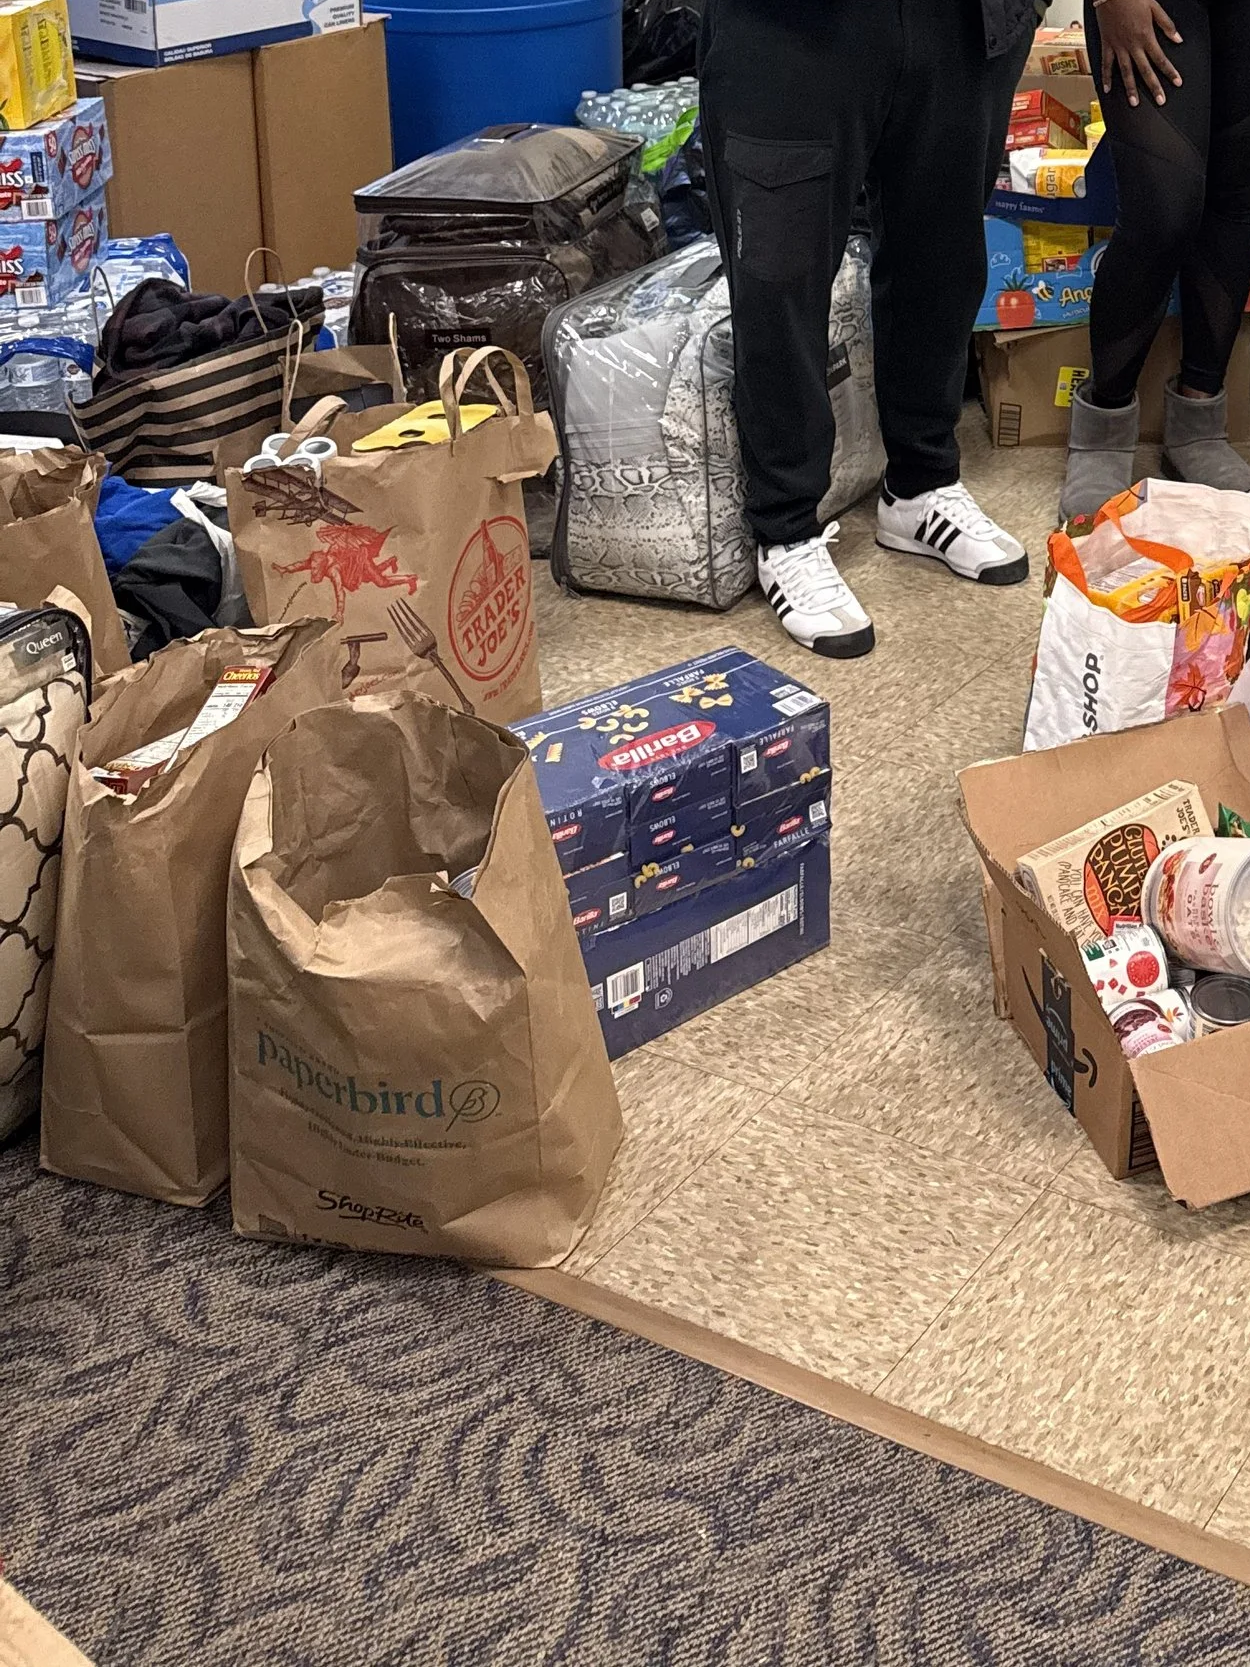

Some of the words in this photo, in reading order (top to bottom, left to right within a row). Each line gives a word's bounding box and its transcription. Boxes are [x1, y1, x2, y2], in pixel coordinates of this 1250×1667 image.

[0, 168, 24, 187] ISS
[0, 255, 24, 274] ISS
[1059, 286, 1093, 308] Ang
[432, 334, 451, 344] Two
[453, 333, 487, 343] Shams
[462, 565, 527, 653] TRADER
[26, 631, 63, 654] Queen
[477, 599, 522, 667] JOE'S
[222, 671, 261, 681] Cheerios
[664, 669, 704, 687] FARFALLE
[581, 700, 618, 715] ELBOWS
[612, 724, 702, 766] Barilla
[759, 724, 795, 746] FARFALLE
[550, 809, 583, 827] ROTIN
[650, 815, 676, 832] ELBOWS
[1176, 807, 1190, 832] JOE'S
[1183, 799, 1200, 835] TRADER
[773, 827, 810, 849] FARFALLE
[1124, 826, 1150, 883] GLUTE
[1070, 866, 1083, 888] YOU
[1090, 845, 1131, 917] PANCA
[1104, 831, 1142, 916] PUMPK
[1072, 889, 1084, 908] CAN
[1208, 883, 1220, 934] bowl
[1063, 904, 1077, 924] AND
[1077, 908, 1093, 933] HAVE
[258, 1030, 446, 1120] paperbird
[316, 1190, 424, 1232] ShopRite
